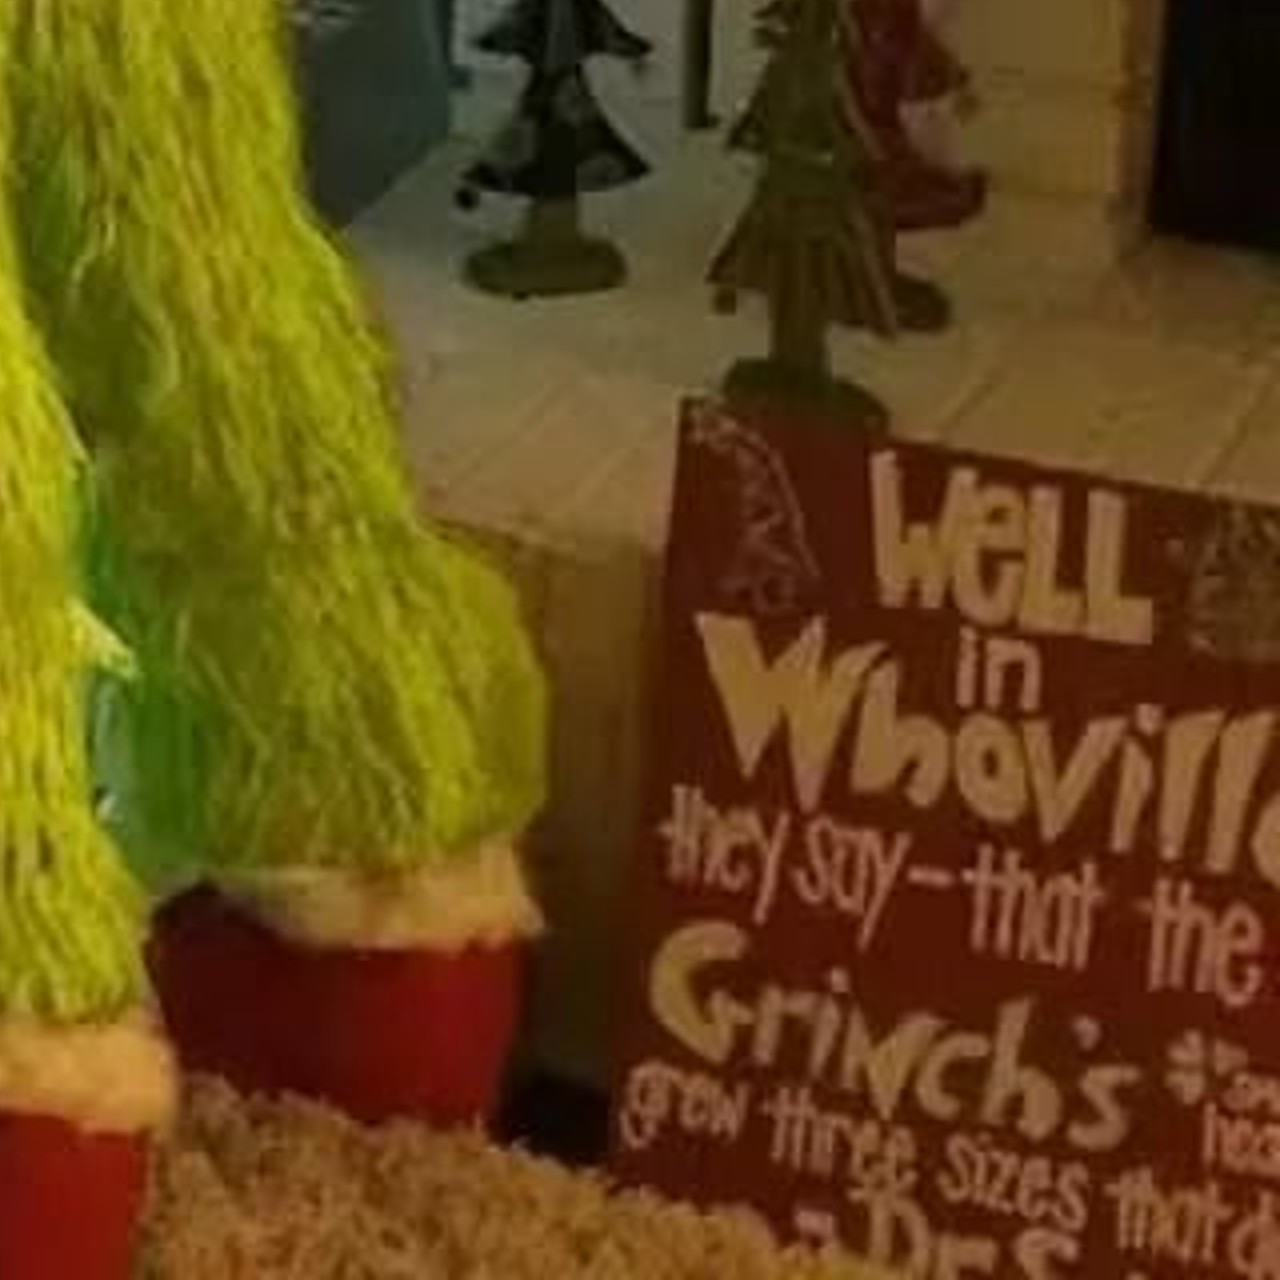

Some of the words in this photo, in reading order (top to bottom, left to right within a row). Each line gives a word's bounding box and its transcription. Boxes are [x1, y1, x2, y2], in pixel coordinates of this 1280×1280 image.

[954, 626, 1040, 710] in
[657, 783, 793, 925] they
[961, 843, 1104, 969] that
[1137, 875, 1264, 1007] the
[937, 1130, 1091, 1234] sizes
[1102, 1168, 1237, 1264] that
